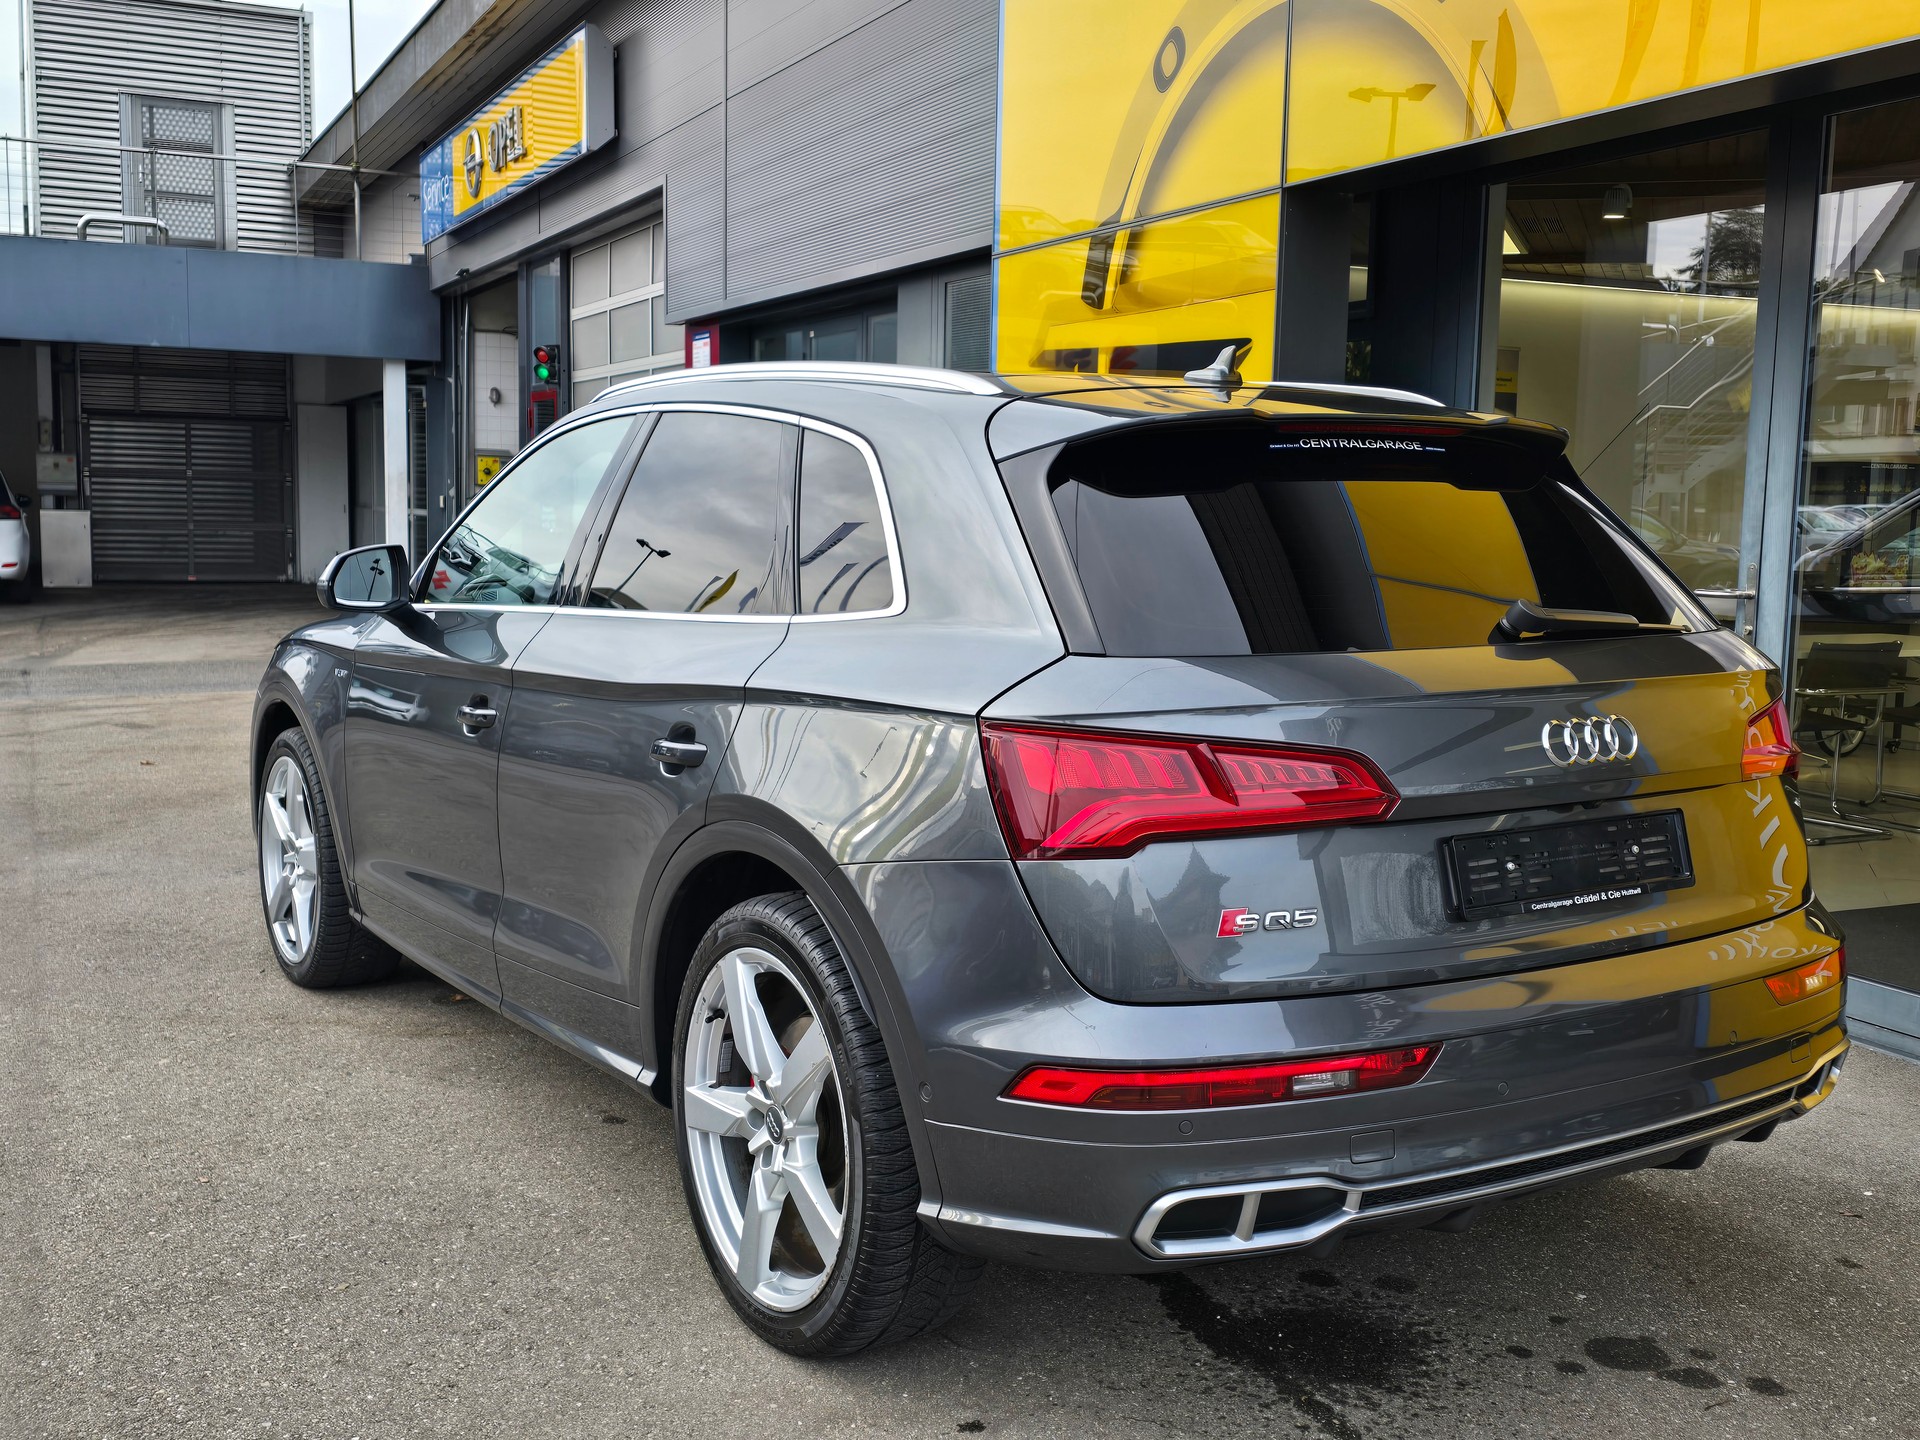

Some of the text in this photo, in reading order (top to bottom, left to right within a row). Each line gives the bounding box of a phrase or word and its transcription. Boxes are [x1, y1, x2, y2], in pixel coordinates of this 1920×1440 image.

[488, 105, 527, 172] OPEL
[423, 171, 449, 213] Service
[1300, 438, 1423, 451] CENTRALGARAGE
[1531, 899, 1573, 911] Centralgarage
[1574, 893, 1600, 904] Grädel
[1601, 891, 1608, 900] &
[1608, 890, 1621, 899] Cie
[1230, 908, 1319, 933] SQ5
